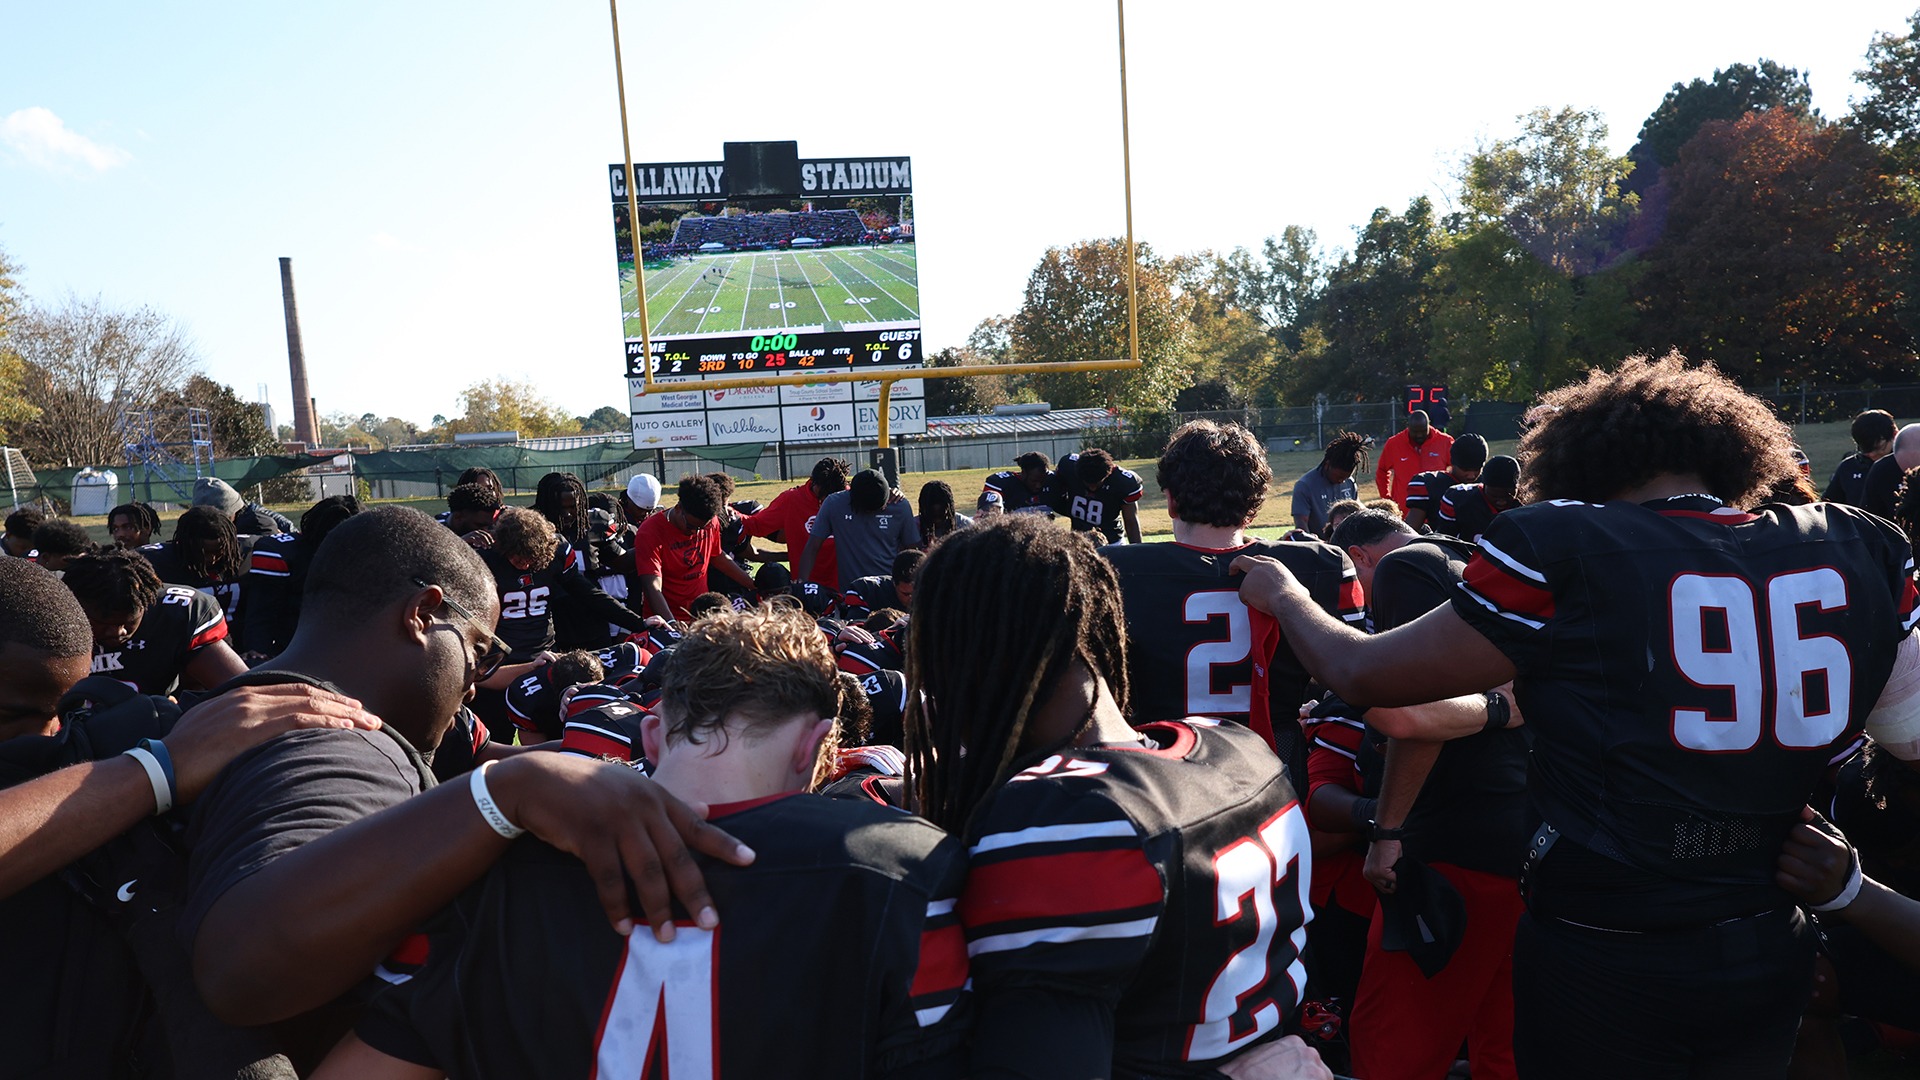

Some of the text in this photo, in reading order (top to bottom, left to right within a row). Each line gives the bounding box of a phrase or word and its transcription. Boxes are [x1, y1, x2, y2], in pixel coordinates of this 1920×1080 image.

[802, 160, 910, 191] STADIUM
[769, 301, 796, 310] 50
[751, 334, 797, 352] 0:00
[880, 331, 920, 341] GUEST
[789, 350, 810, 358] BALL
[872, 351, 882, 362] 0
[898, 343, 912, 360] 6
[671, 360, 682, 372] 2
[699, 361, 726, 372] 3RD
[738, 360, 754, 370] 10
[765, 353, 786, 367] 25
[798, 356, 815, 366] 42
[676, 393, 697, 401] Georgia
[634, 419, 704, 430] AUTO GALLERY
[712, 417, 778, 437] Milliken
[798, 423, 841, 435] jackson
[1071, 495, 1103, 525] 68
[163, 586, 196, 607] 58
[502, 586, 550, 619] 26
[1183, 588, 1252, 716] 2
[1668, 565, 1854, 754] 96
[520, 675, 543, 697] 44
[1181, 799, 1316, 1063] 27
[588, 917, 721, 1080] 4
